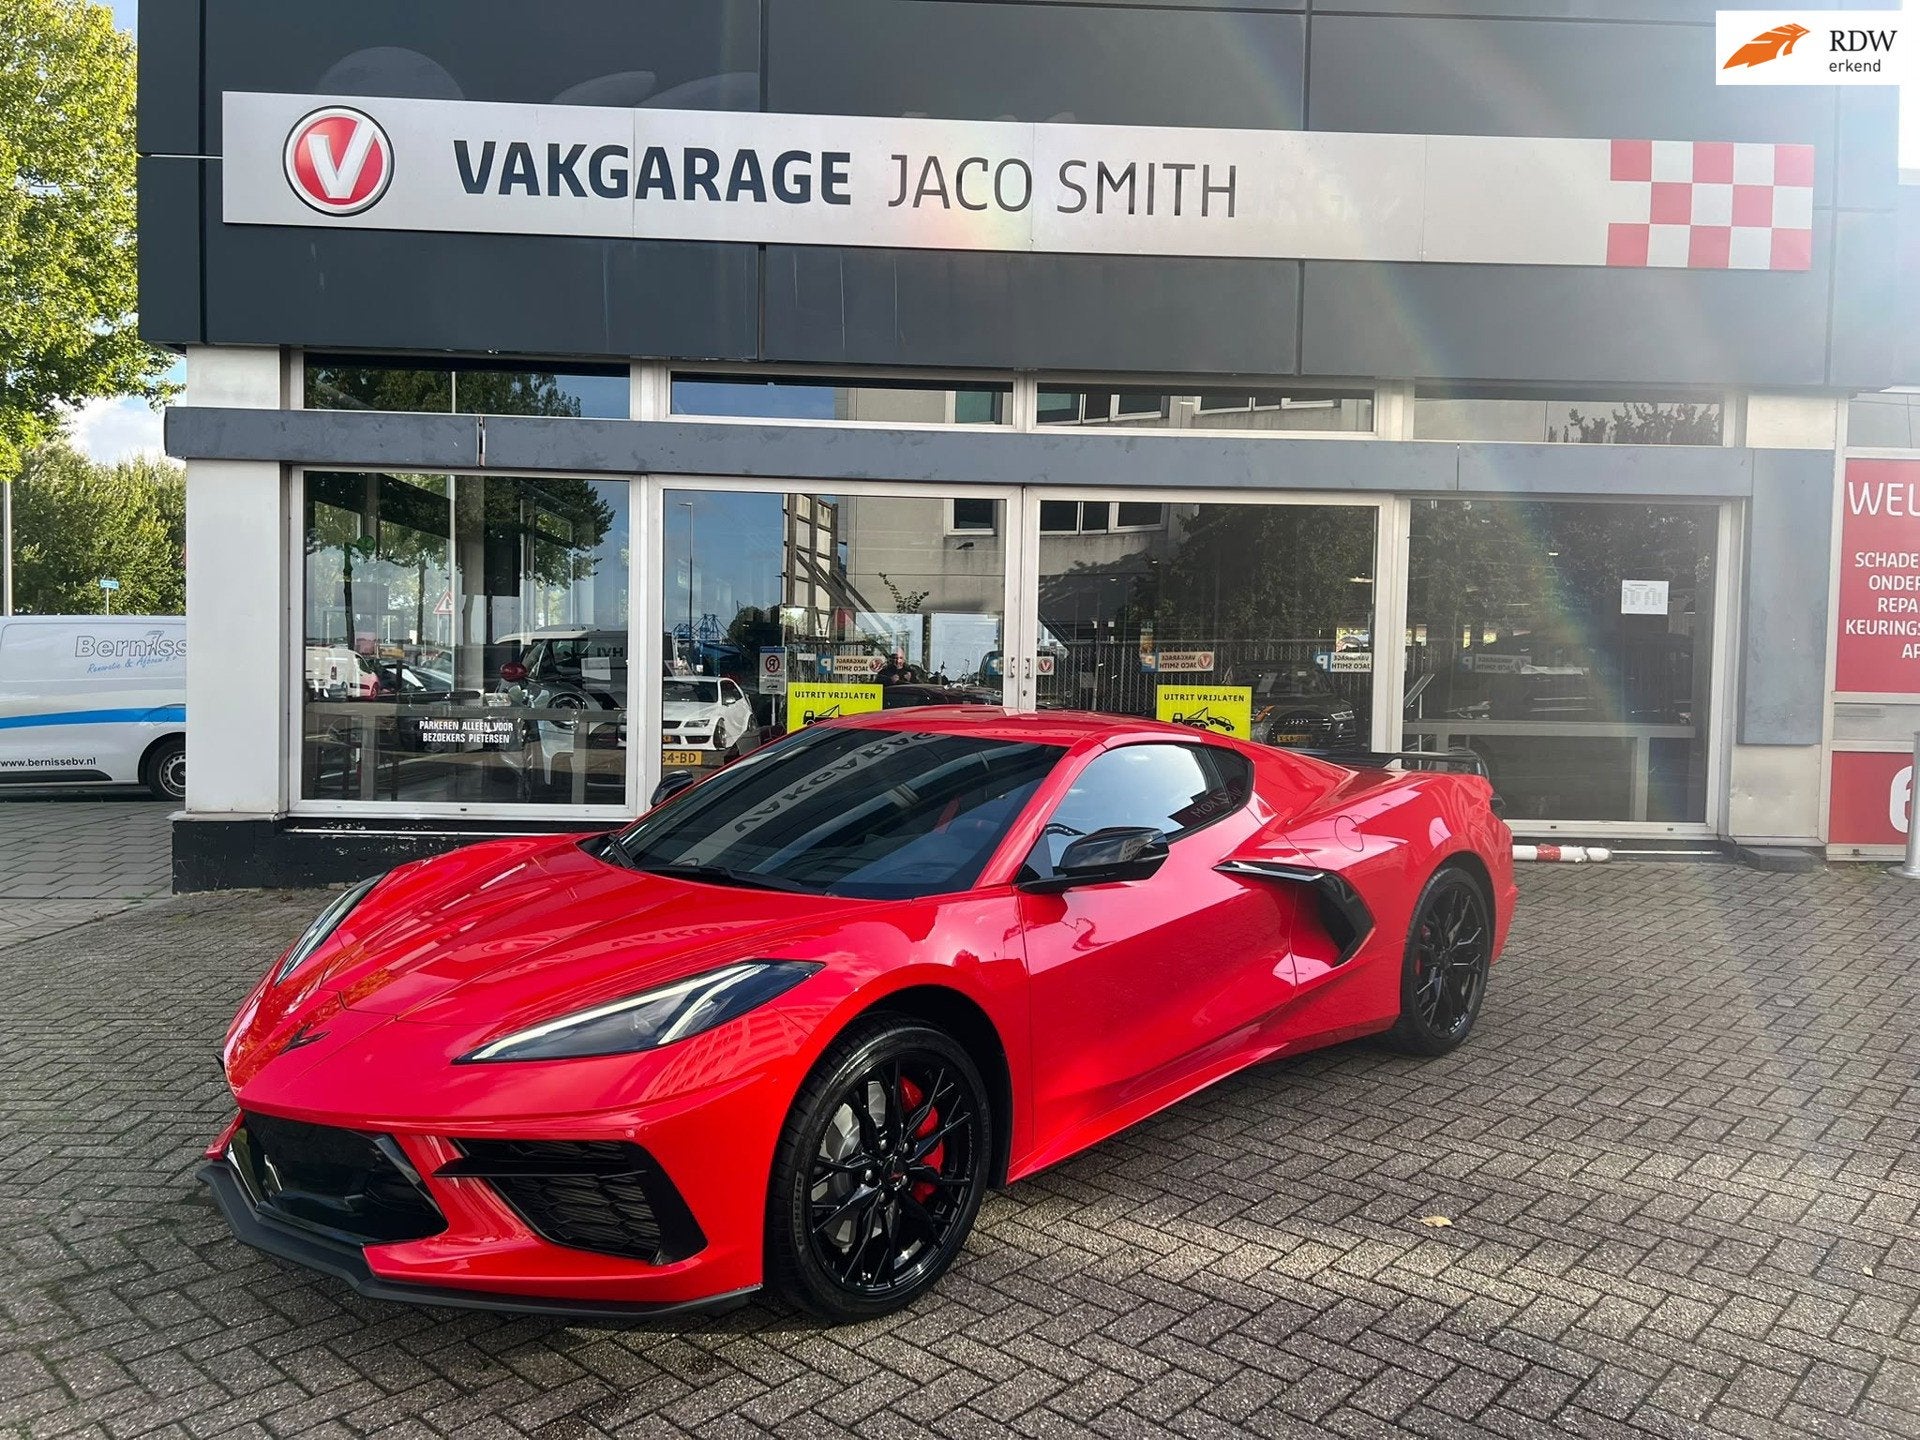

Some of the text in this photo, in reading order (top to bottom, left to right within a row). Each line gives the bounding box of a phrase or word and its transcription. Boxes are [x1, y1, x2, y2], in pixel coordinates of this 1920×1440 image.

[454, 140, 1237, 217] VAKGARAGE JACO SMITH
[1855, 552, 1919, 568] SCHADE
[1846, 619, 1920, 635] KEURING
[1197, 694, 1245, 702] VRIJLATEN
[420, 721, 513, 731] PARKEREN ALLEEN VOOR
[423, 733, 510, 743] BEZOEKERS PIETERSEN
[0, 757, 96, 767] www.bernissebv.nl
